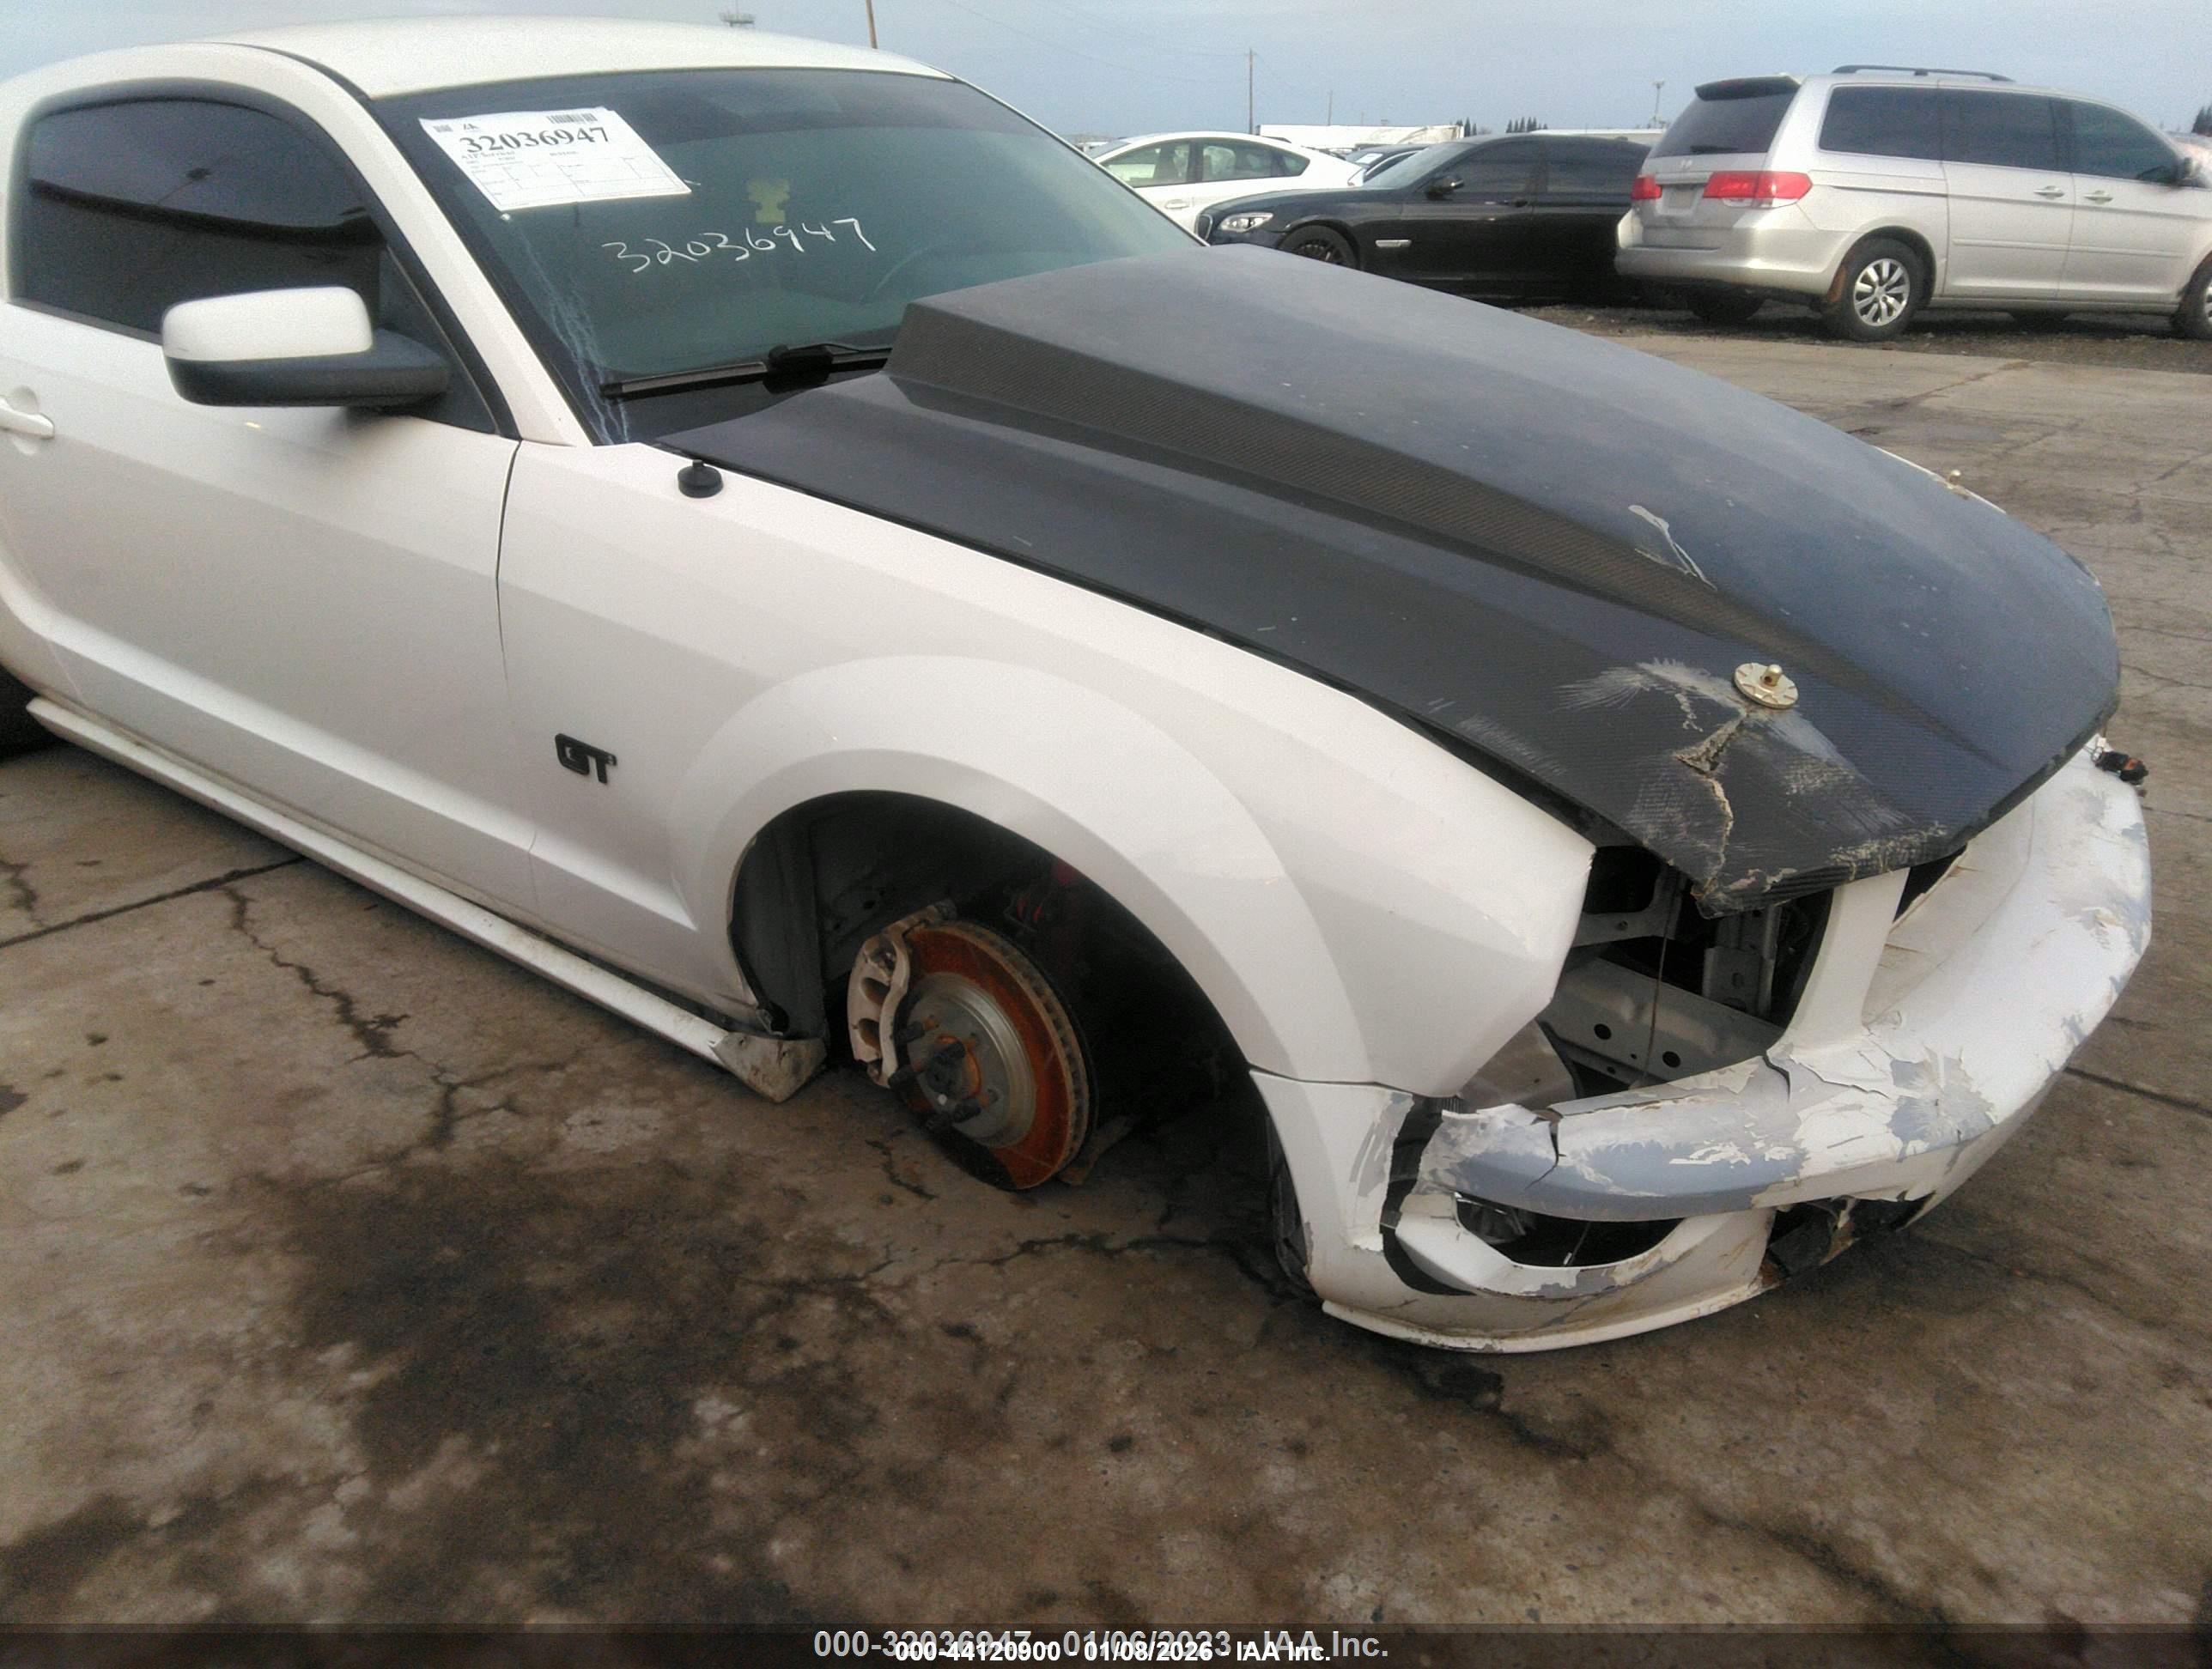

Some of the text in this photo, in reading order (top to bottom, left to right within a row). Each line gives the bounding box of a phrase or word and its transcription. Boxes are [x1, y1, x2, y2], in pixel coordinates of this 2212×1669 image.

[459, 126, 610, 153] 32036947
[601, 216, 877, 273] 32036947
[555, 733, 617, 784] GT
